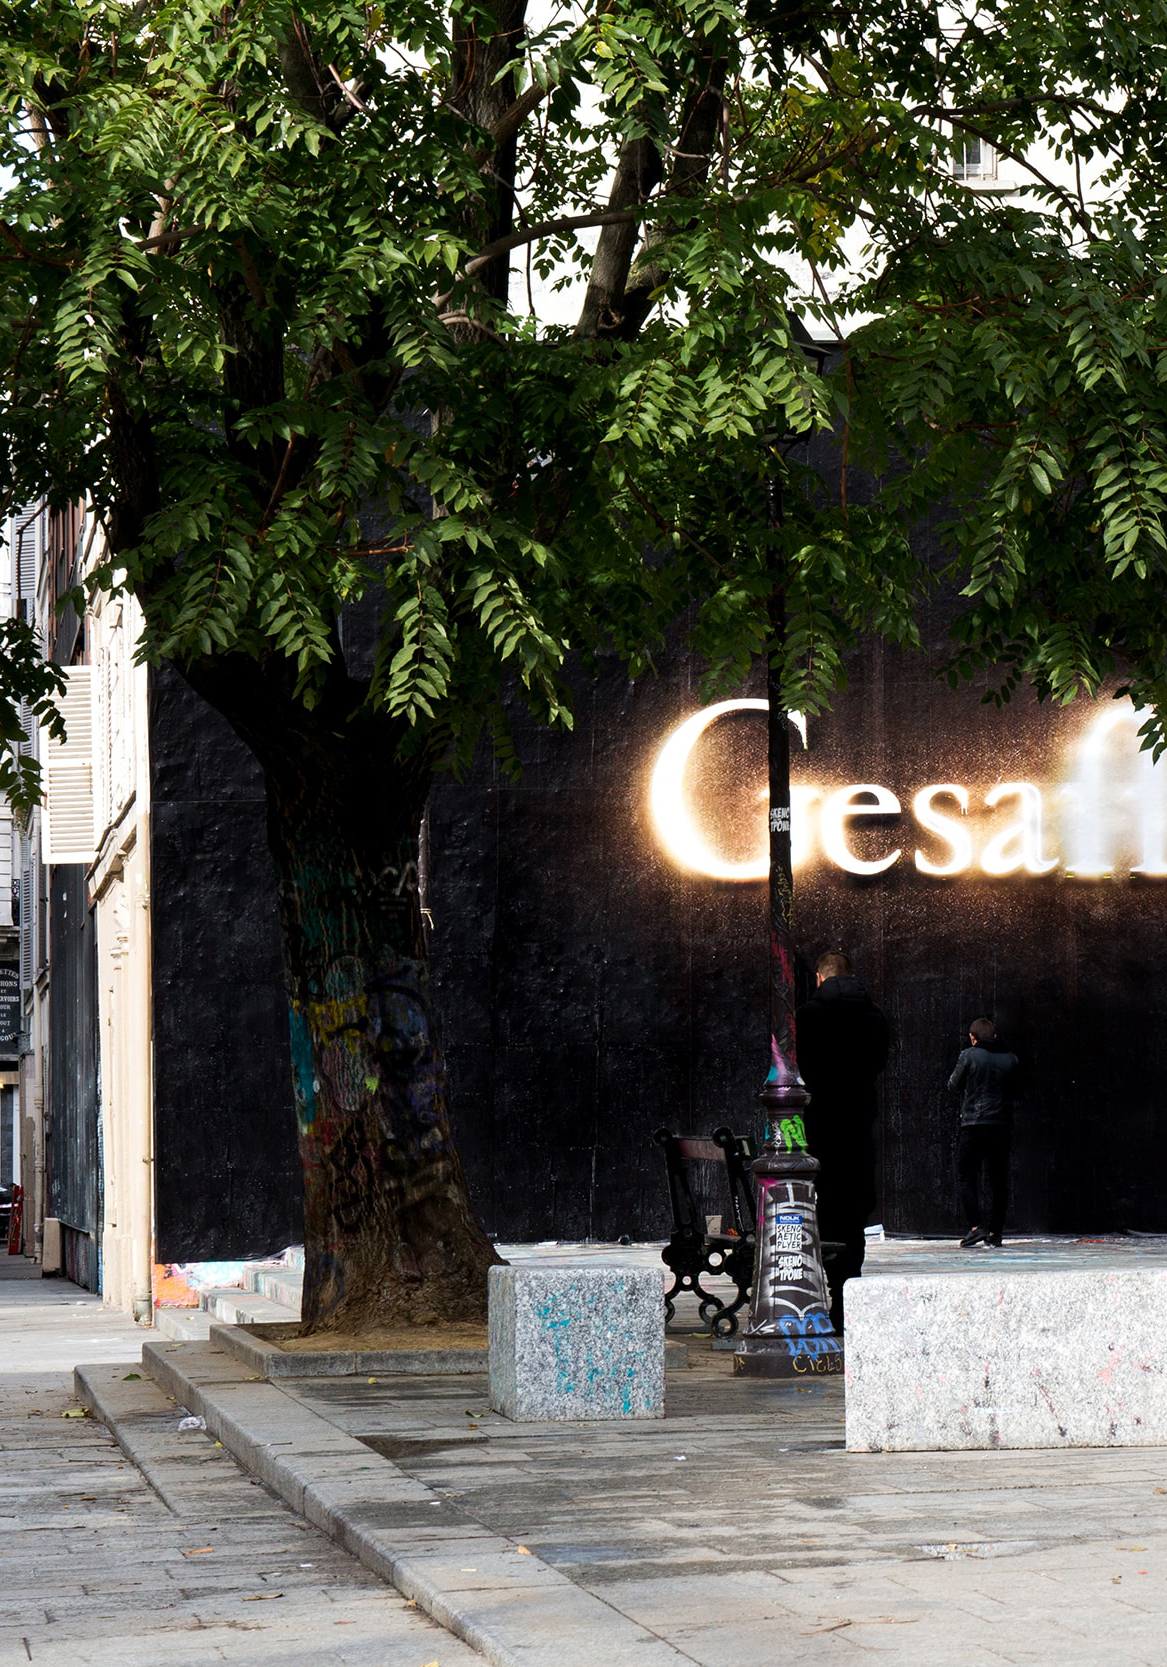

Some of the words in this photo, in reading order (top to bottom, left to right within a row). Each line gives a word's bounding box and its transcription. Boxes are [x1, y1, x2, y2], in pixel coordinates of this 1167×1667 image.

[777, 1224, 802, 1233] SKENO
[777, 1241, 802, 1250] PLYER
[778, 1254, 803, 1268] SKENO
